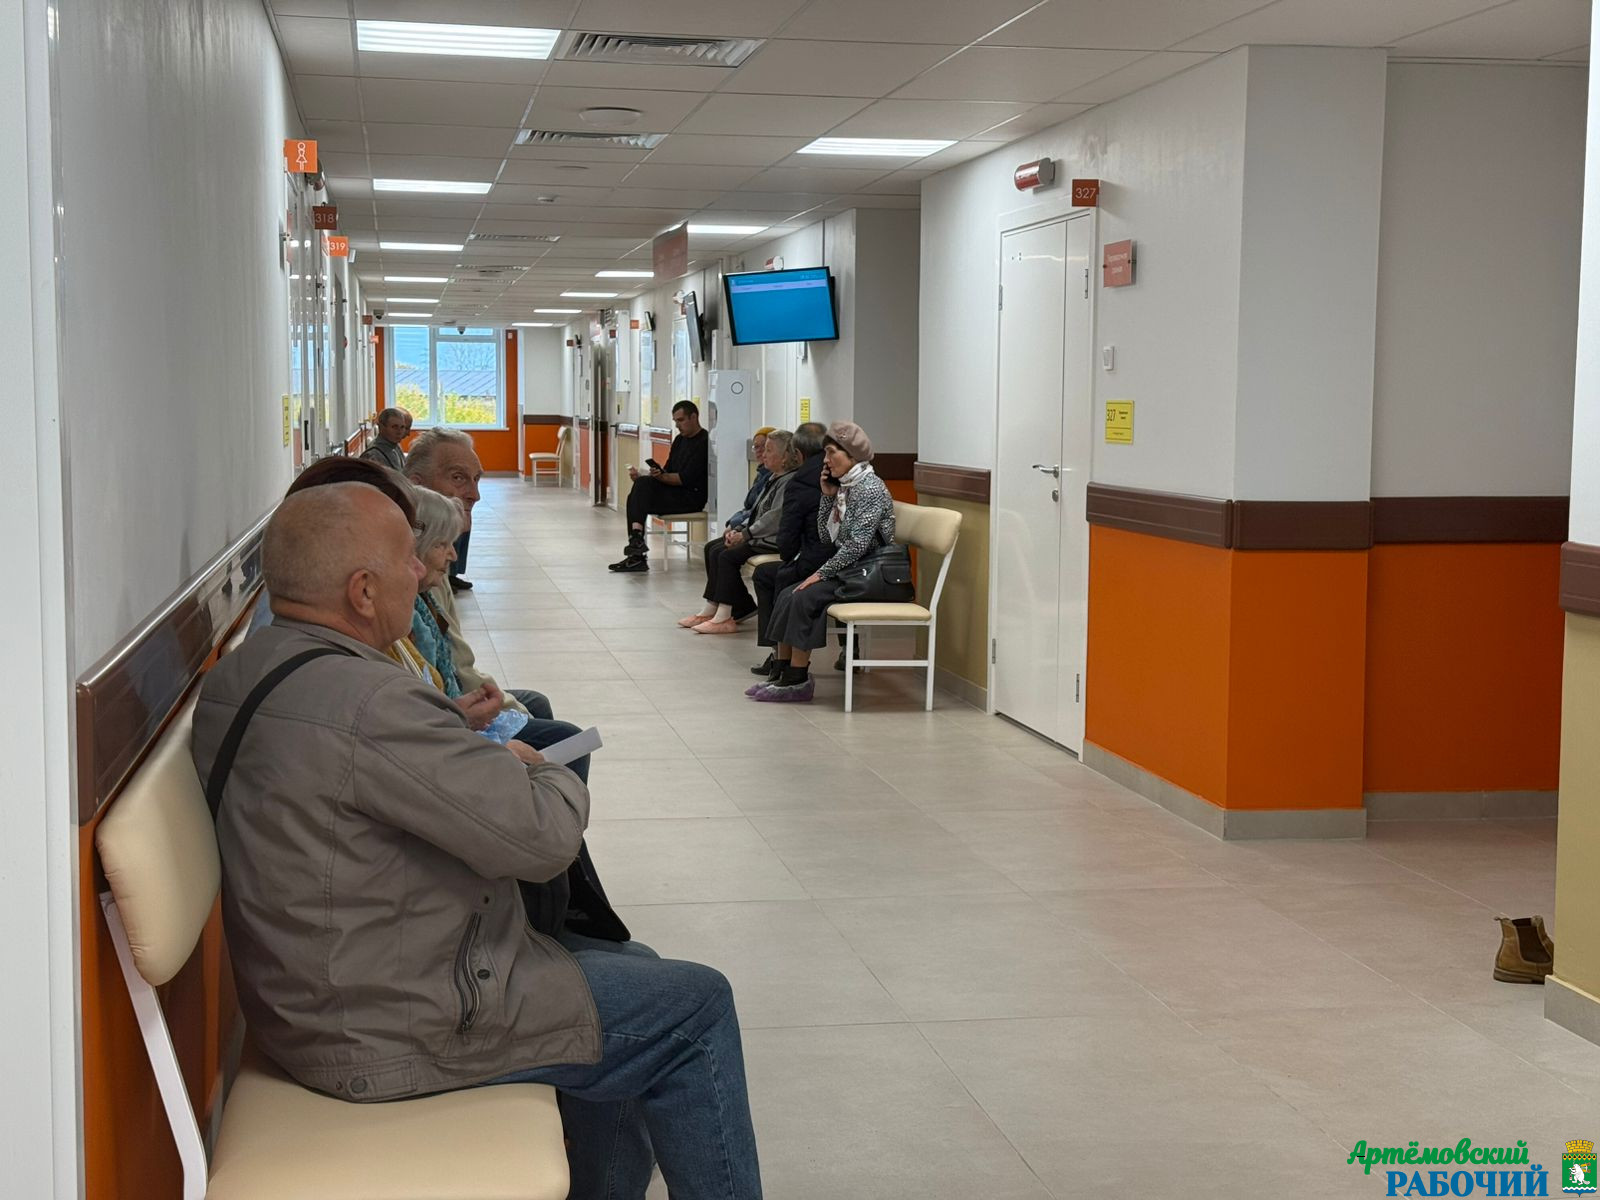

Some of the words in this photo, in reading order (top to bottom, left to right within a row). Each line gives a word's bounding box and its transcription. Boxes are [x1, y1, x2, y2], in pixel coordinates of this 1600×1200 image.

[1075, 187, 1097, 199] 327
[315, 213, 335, 224] 318
[330, 241, 346, 251] 319
[1106, 408, 1116, 422] 327
